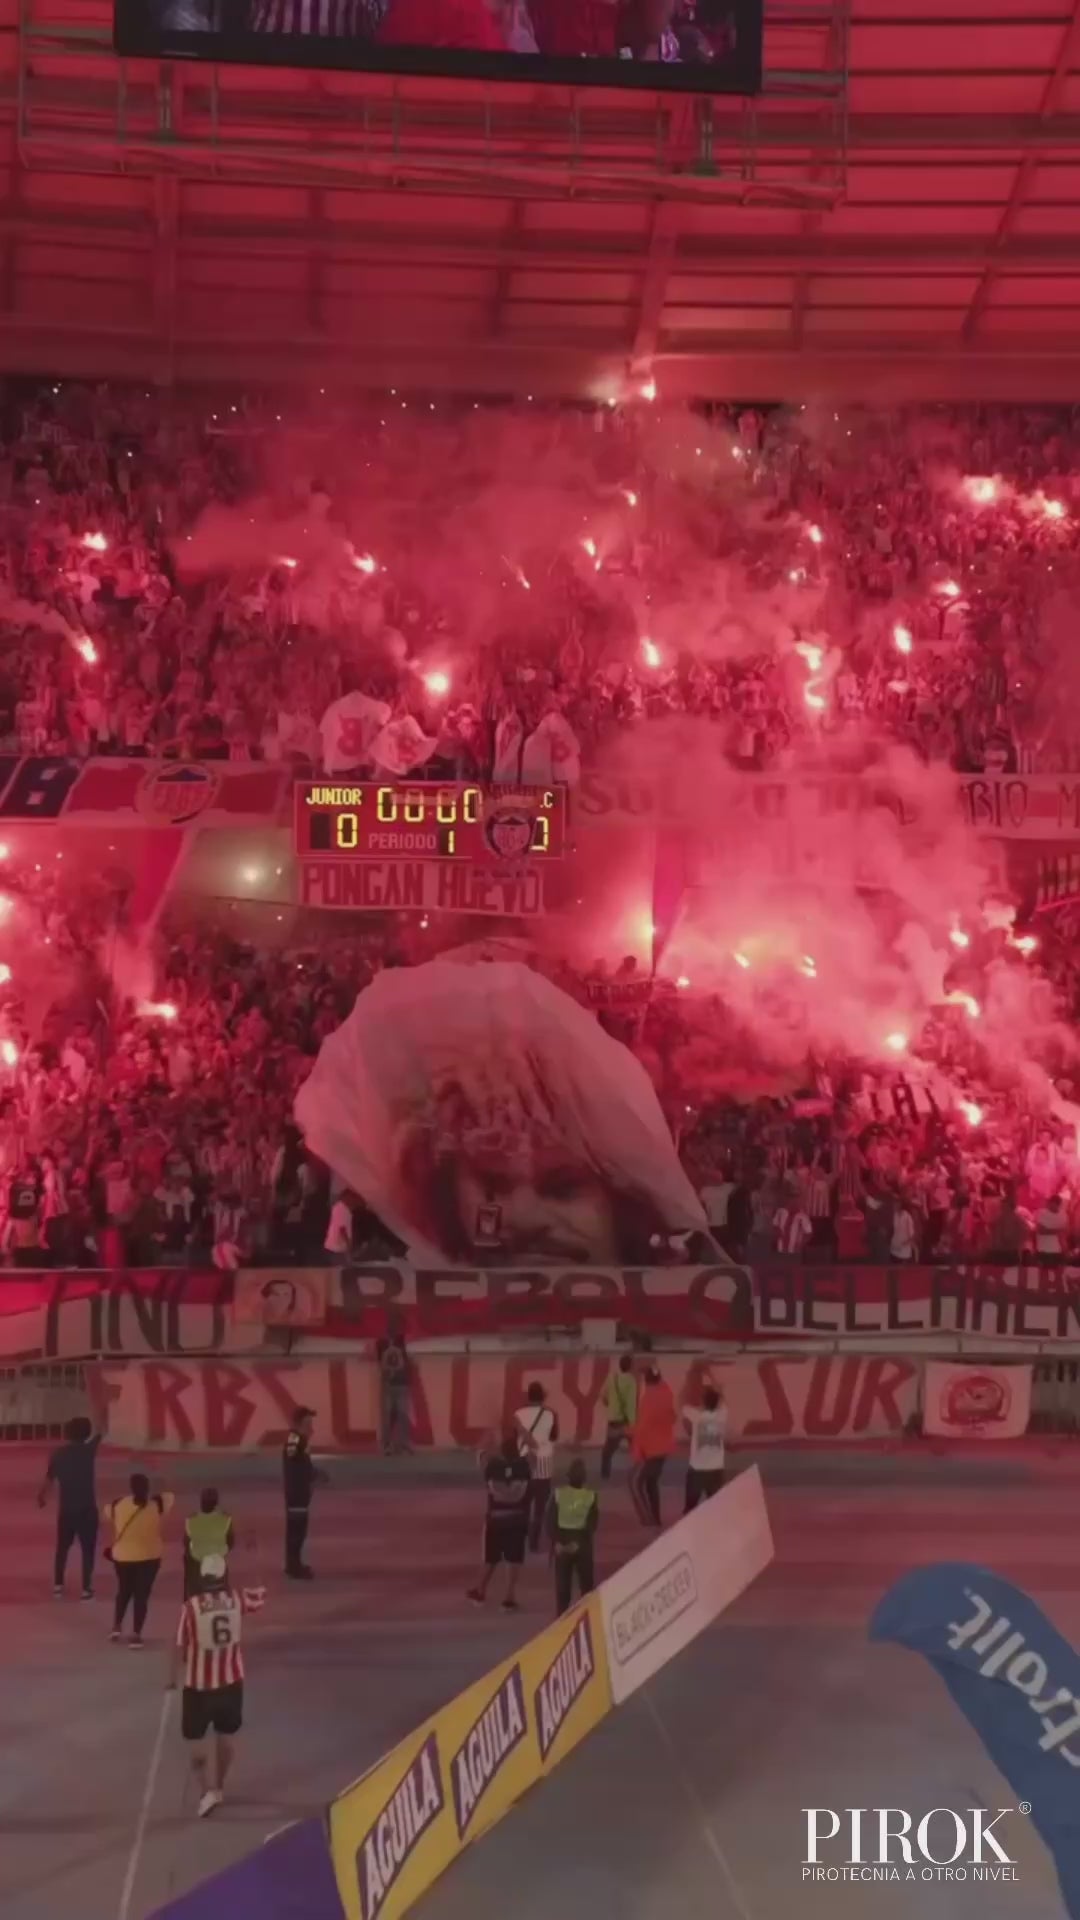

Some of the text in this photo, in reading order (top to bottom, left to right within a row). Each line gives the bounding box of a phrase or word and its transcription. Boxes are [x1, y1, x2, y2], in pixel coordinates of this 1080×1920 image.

[306, 788, 362, 805] JUNIOR
[337, 813, 358, 848] 0
[368, 832, 437, 849] PERIODO
[303, 862, 424, 907] PONGAN
[742, 1357, 917, 1436] SUR
[212, 1615, 231, 1646] 6
[538, 1620, 593, 1755] AGUILA
[454, 1672, 524, 1831] AGUILA
[365, 1743, 441, 1920] AGUILA
